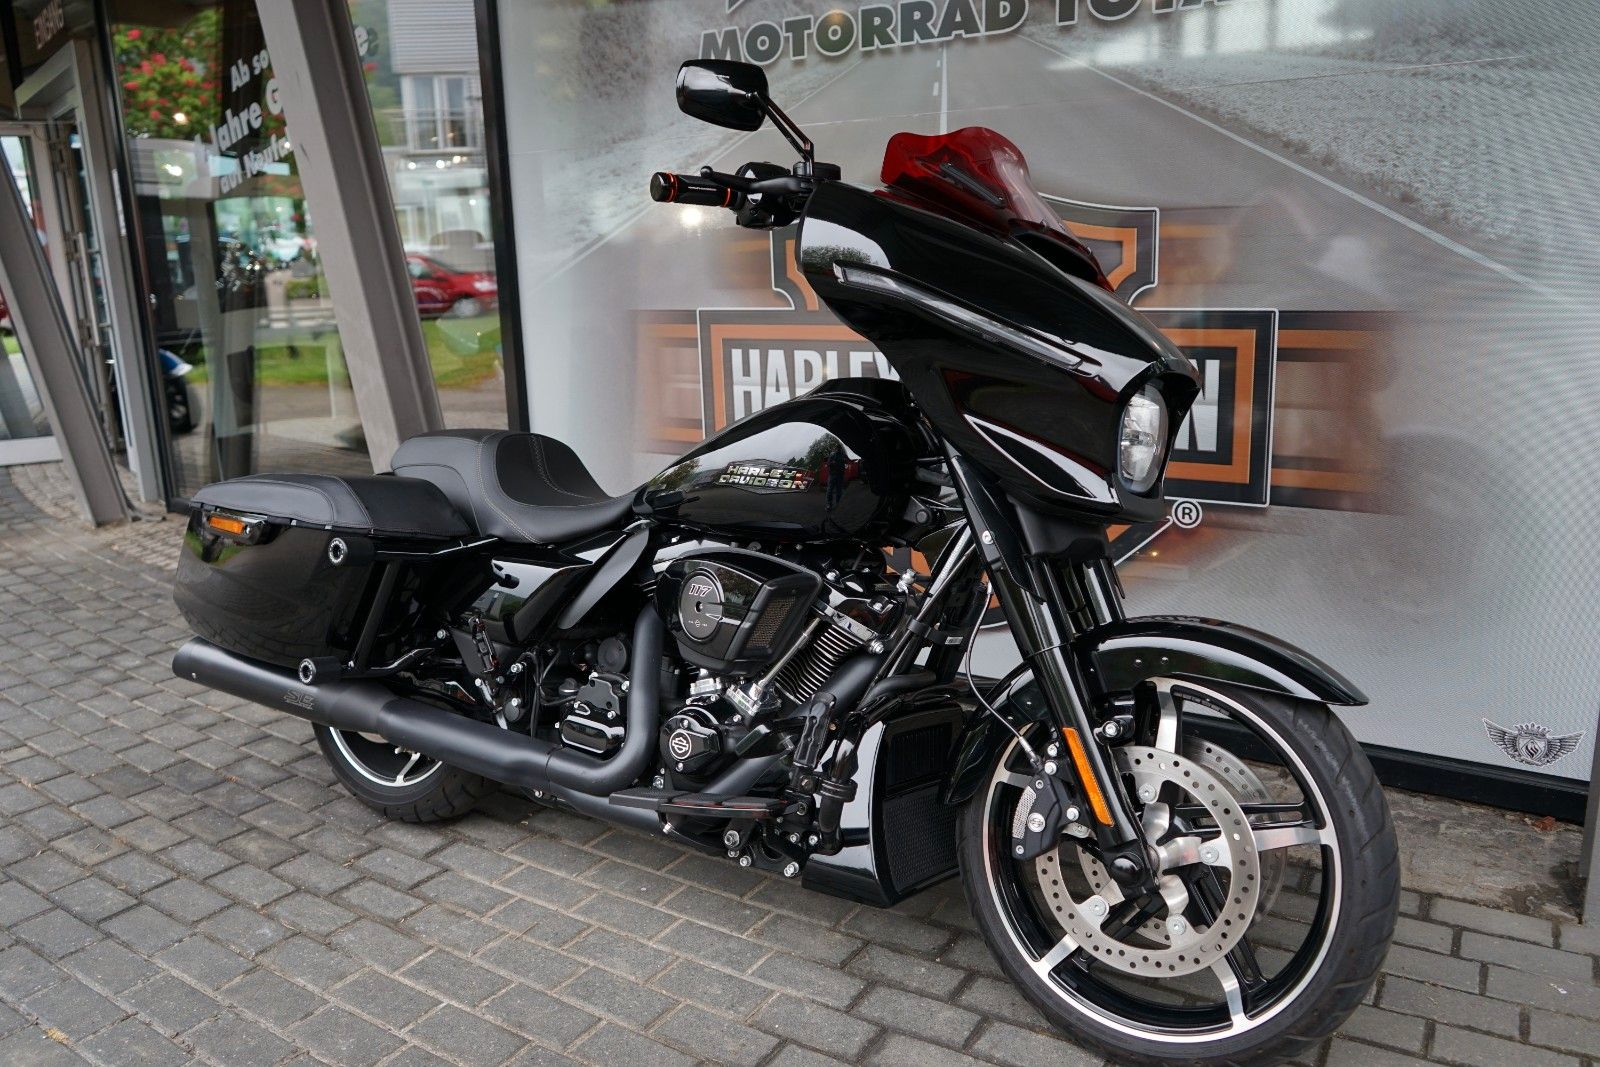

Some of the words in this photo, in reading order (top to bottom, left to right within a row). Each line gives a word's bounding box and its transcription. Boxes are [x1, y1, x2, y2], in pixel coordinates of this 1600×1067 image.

[700, 0, 1029, 65] MOTORRAD
[230, 58, 250, 92] Ab
[719, 474, 808, 489] DAVIDSON
[689, 584, 713, 597] 117
